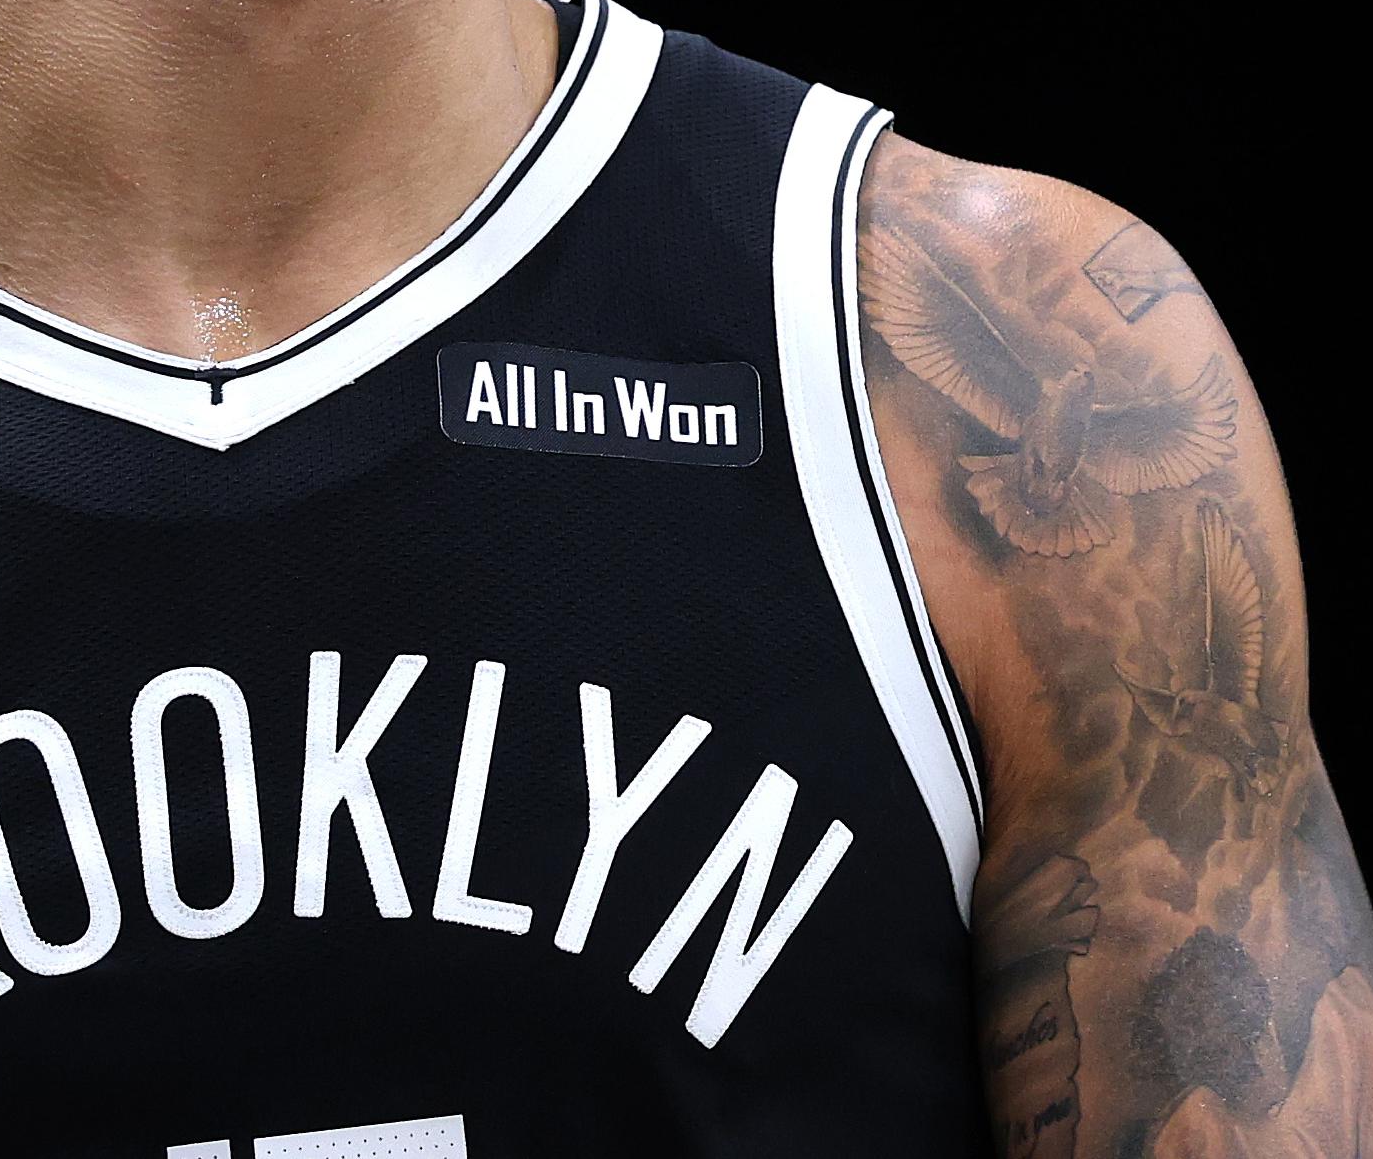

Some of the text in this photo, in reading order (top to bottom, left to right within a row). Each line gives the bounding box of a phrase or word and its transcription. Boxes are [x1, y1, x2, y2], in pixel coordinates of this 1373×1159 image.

[465, 360, 738, 446] All In Won
